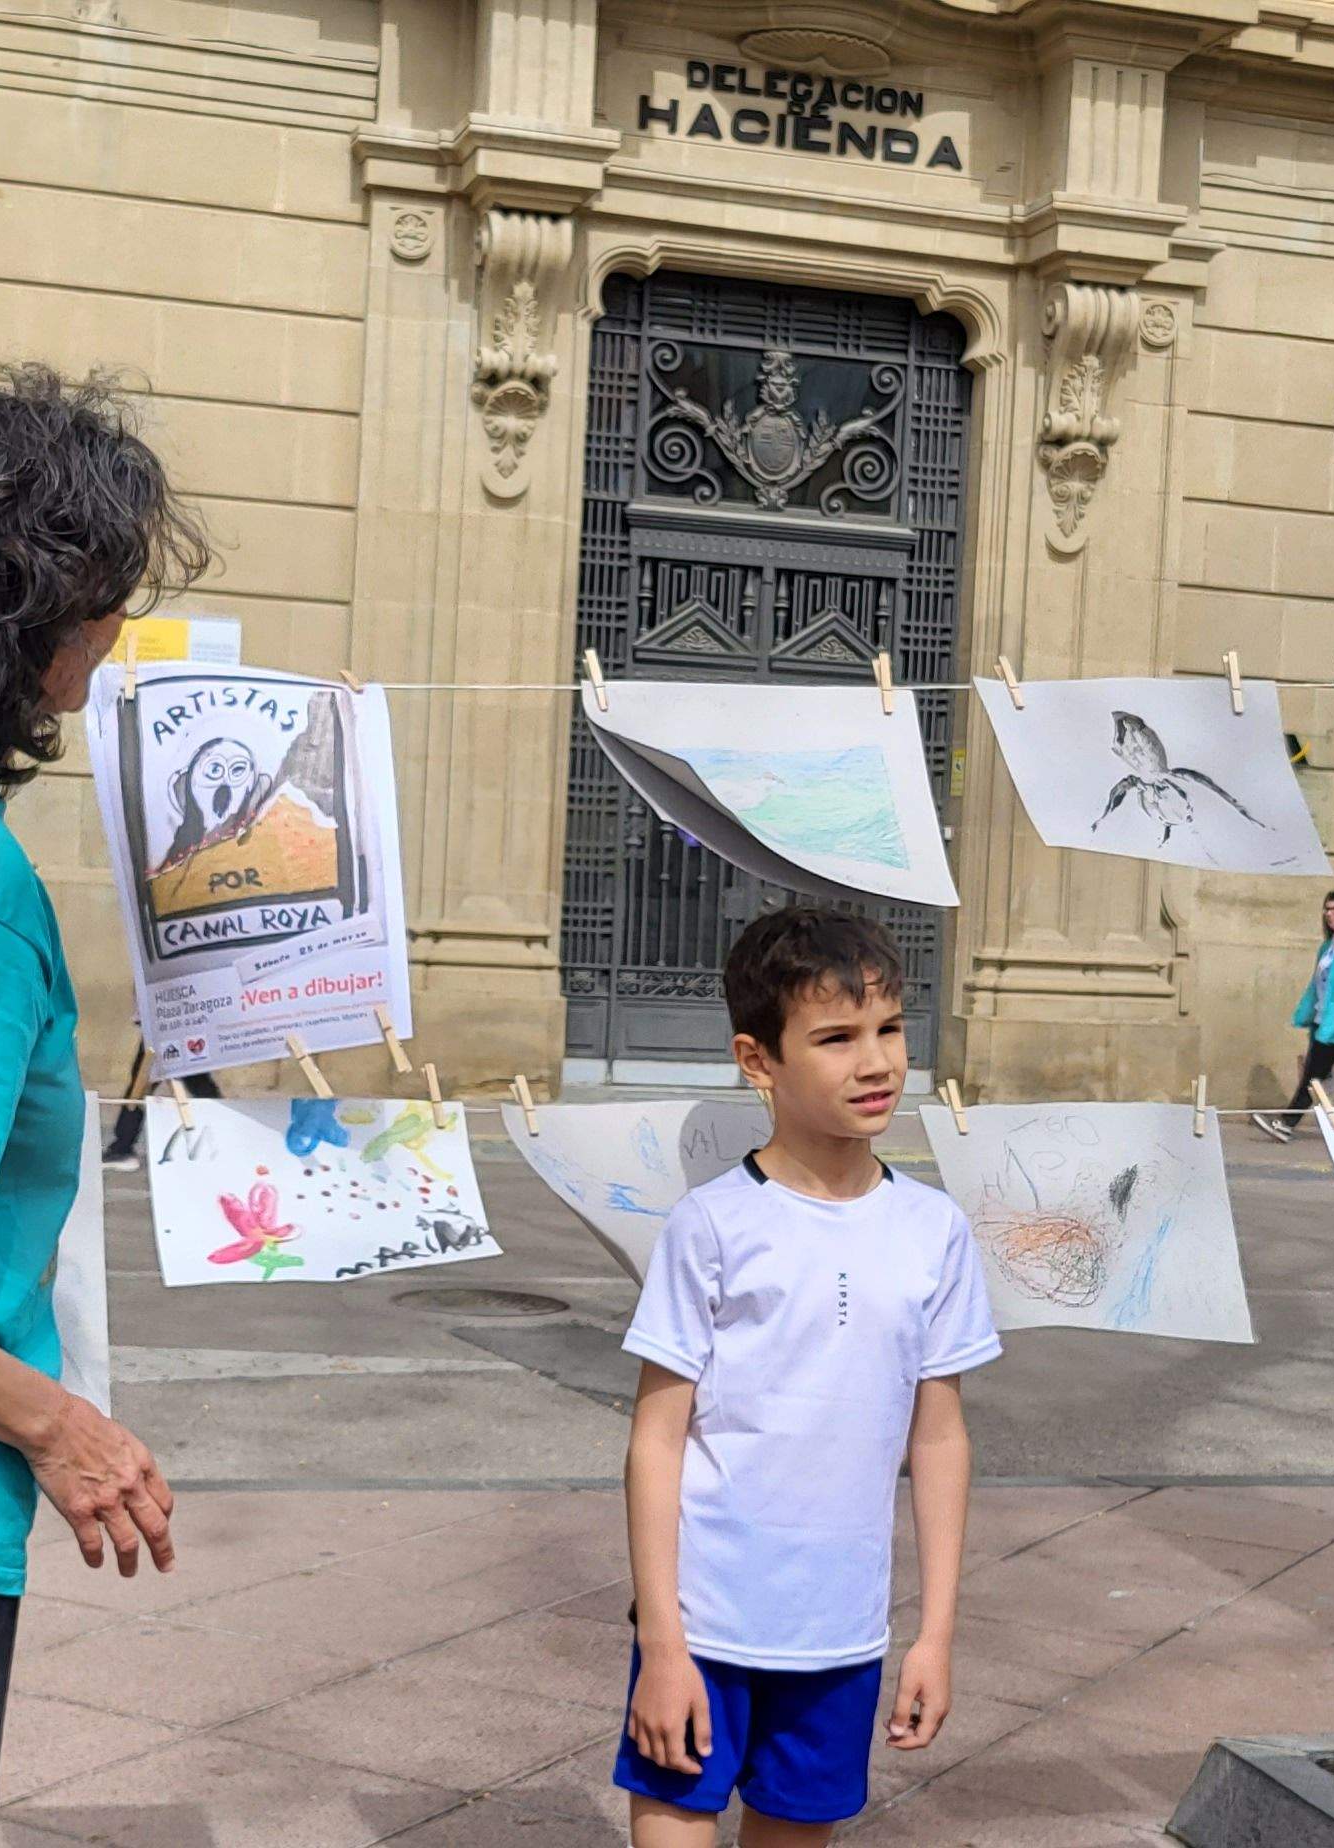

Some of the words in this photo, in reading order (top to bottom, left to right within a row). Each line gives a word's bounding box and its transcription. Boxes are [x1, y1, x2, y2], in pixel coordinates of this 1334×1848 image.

[686, 60, 924, 118] DELEGACION
[786, 102, 831, 119] DE
[637, 94, 963, 171] HACIENDA
[153, 687, 299, 746] ARTISTAS
[208, 868, 263, 892] POR
[164, 914, 250, 947] CANAL
[259, 905, 332, 931] ROYA
[183, 996, 233, 1014] Zaragoza
[240, 988, 282, 1012] ¡Ven
[288, 986, 298, 999] a
[305, 971, 382, 997] dibujar!
[838, 1272, 847, 1326] KIPSTA
